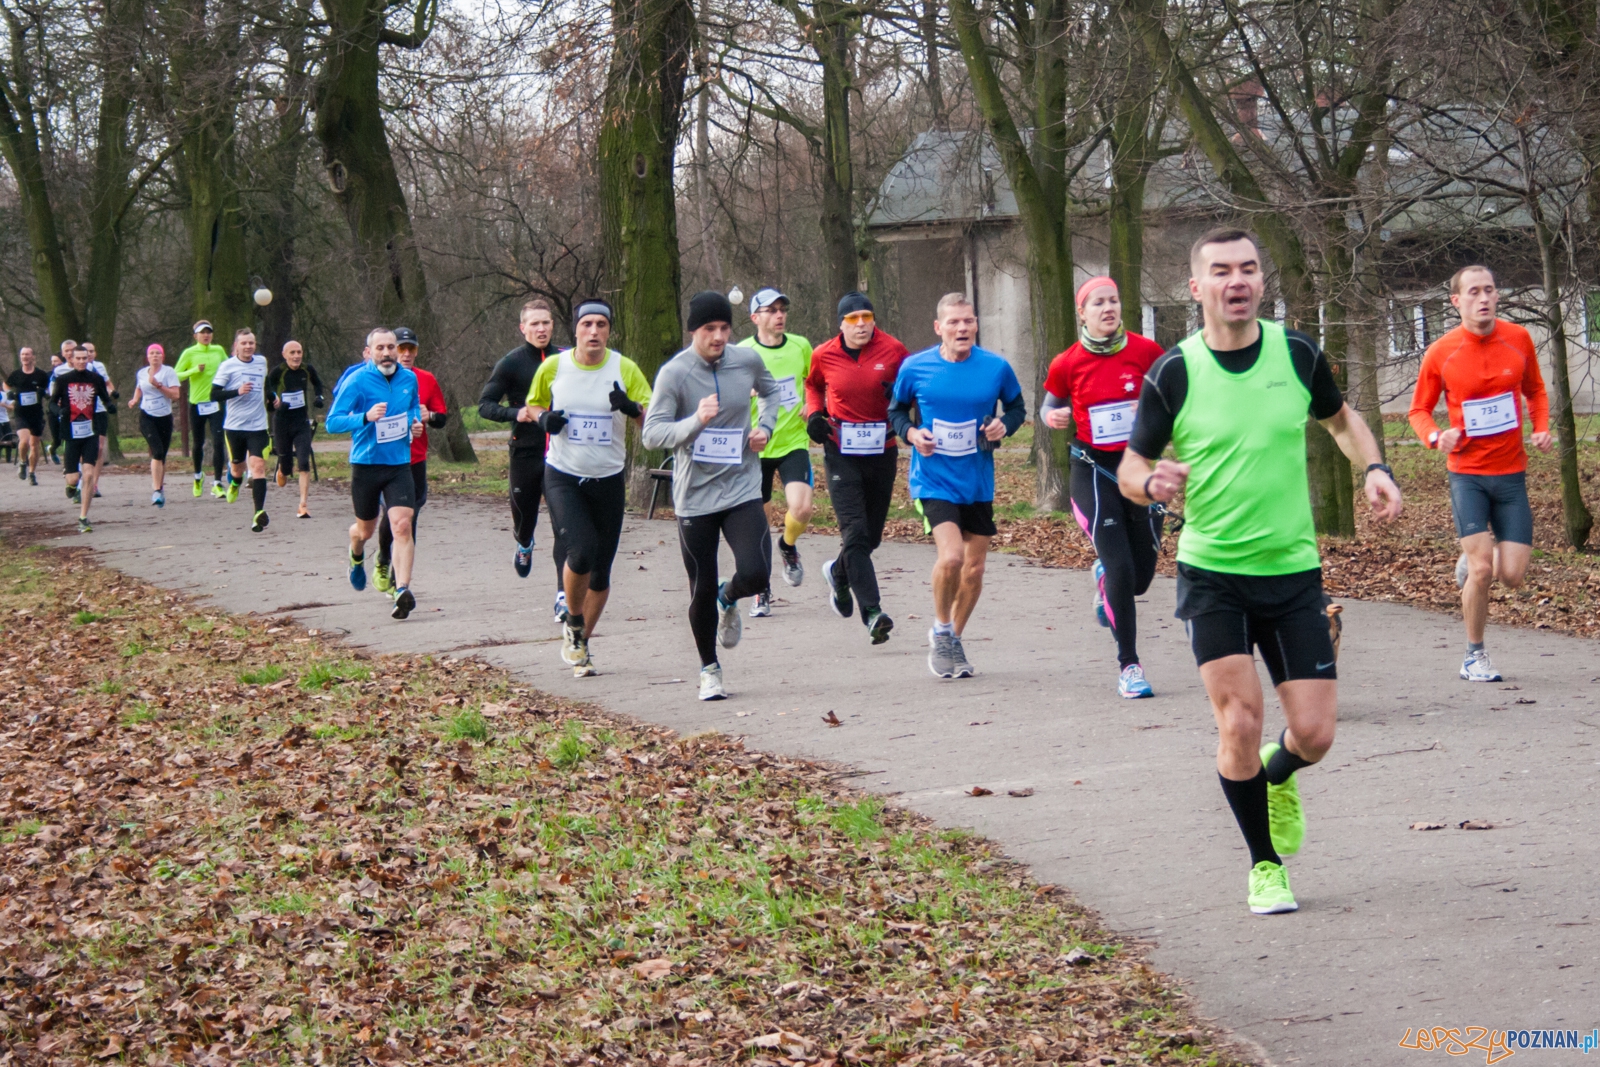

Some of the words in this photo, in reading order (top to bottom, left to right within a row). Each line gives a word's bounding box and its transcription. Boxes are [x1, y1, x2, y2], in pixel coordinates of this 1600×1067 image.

[1481, 405, 1499, 415] 732
[1111, 412, 1122, 421] 28
[856, 430, 871, 438] 534
[712, 437, 728, 445] 952
